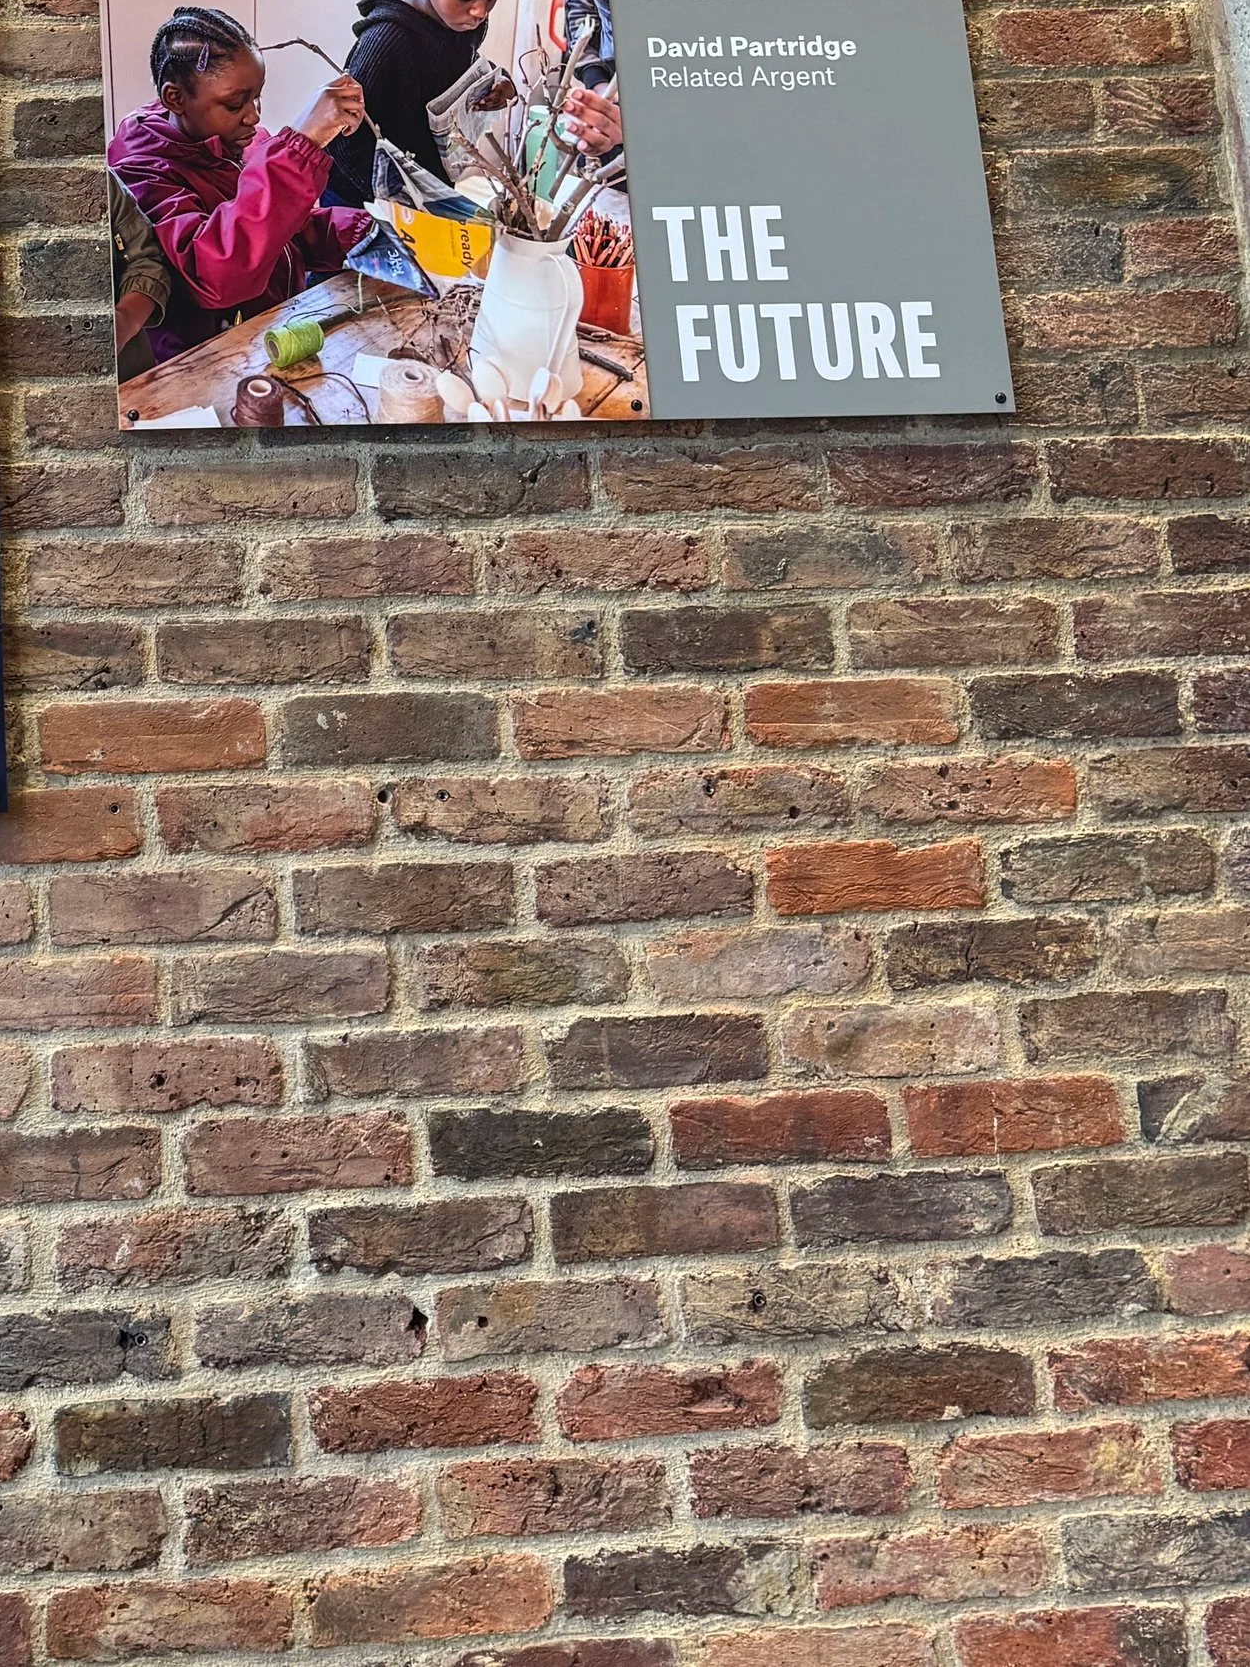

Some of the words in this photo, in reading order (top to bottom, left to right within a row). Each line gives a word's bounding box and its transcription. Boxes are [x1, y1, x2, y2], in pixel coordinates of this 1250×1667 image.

[647, 36, 724, 58] David
[730, 34, 857, 61] Partridge
[650, 65, 744, 88] Related
[751, 65, 837, 91] Argent
[459, 227, 473, 269] ready
[651, 205, 789, 282] THE
[675, 301, 941, 383] FUTURE
